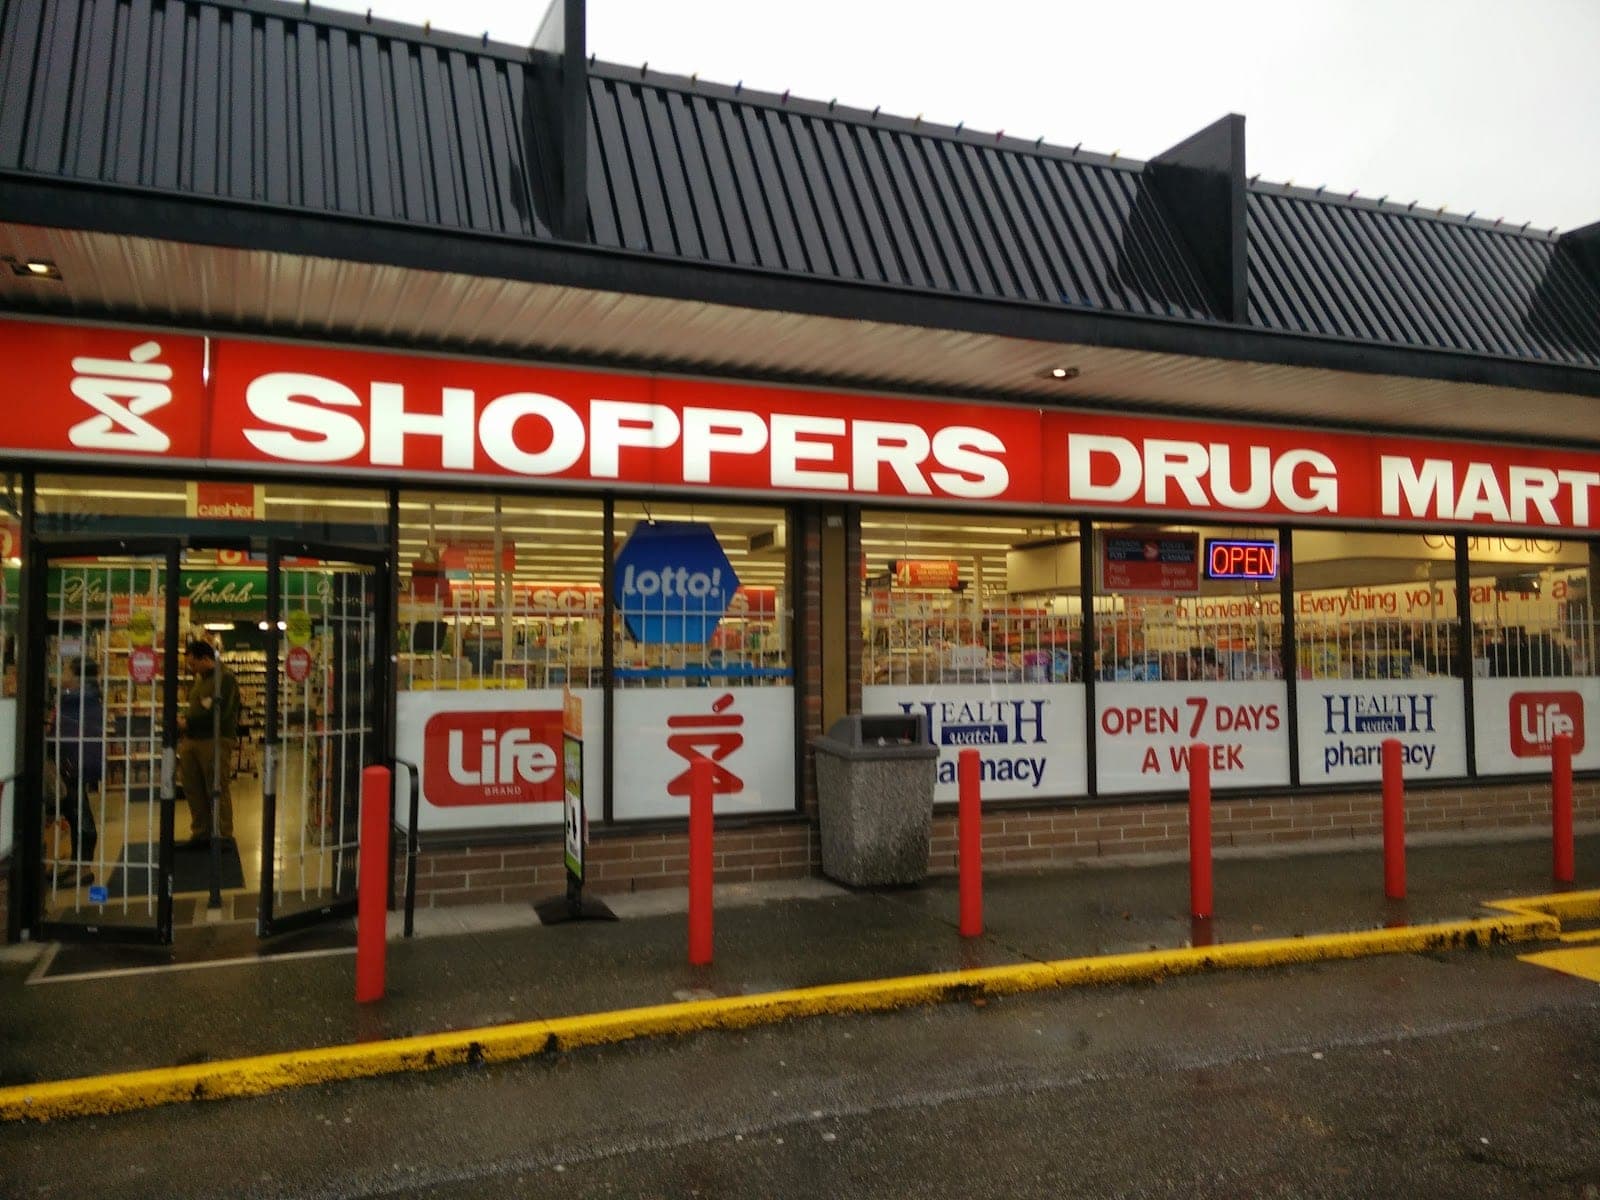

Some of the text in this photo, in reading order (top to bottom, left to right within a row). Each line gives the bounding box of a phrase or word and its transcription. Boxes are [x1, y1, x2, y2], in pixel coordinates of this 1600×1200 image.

[242, 371, 1600, 528] SHOPPERS DRUG MART
[199, 502, 253, 518] cashier
[1212, 545, 1275, 575] OPEN
[1300, 587, 1398, 616] Everything
[1552, 579, 1568, 600] a
[1101, 696, 1281, 738] OPEN 7 DAYS
[1322, 693, 1437, 734] HEALTH
[1519, 703, 1575, 744] Life
[949, 724, 999, 745] watch
[448, 728, 558, 785] Life
[1141, 743, 1245, 774] A WEK
[1324, 740, 1436, 775] pharacy
[484, 785, 523, 797] BRAND
